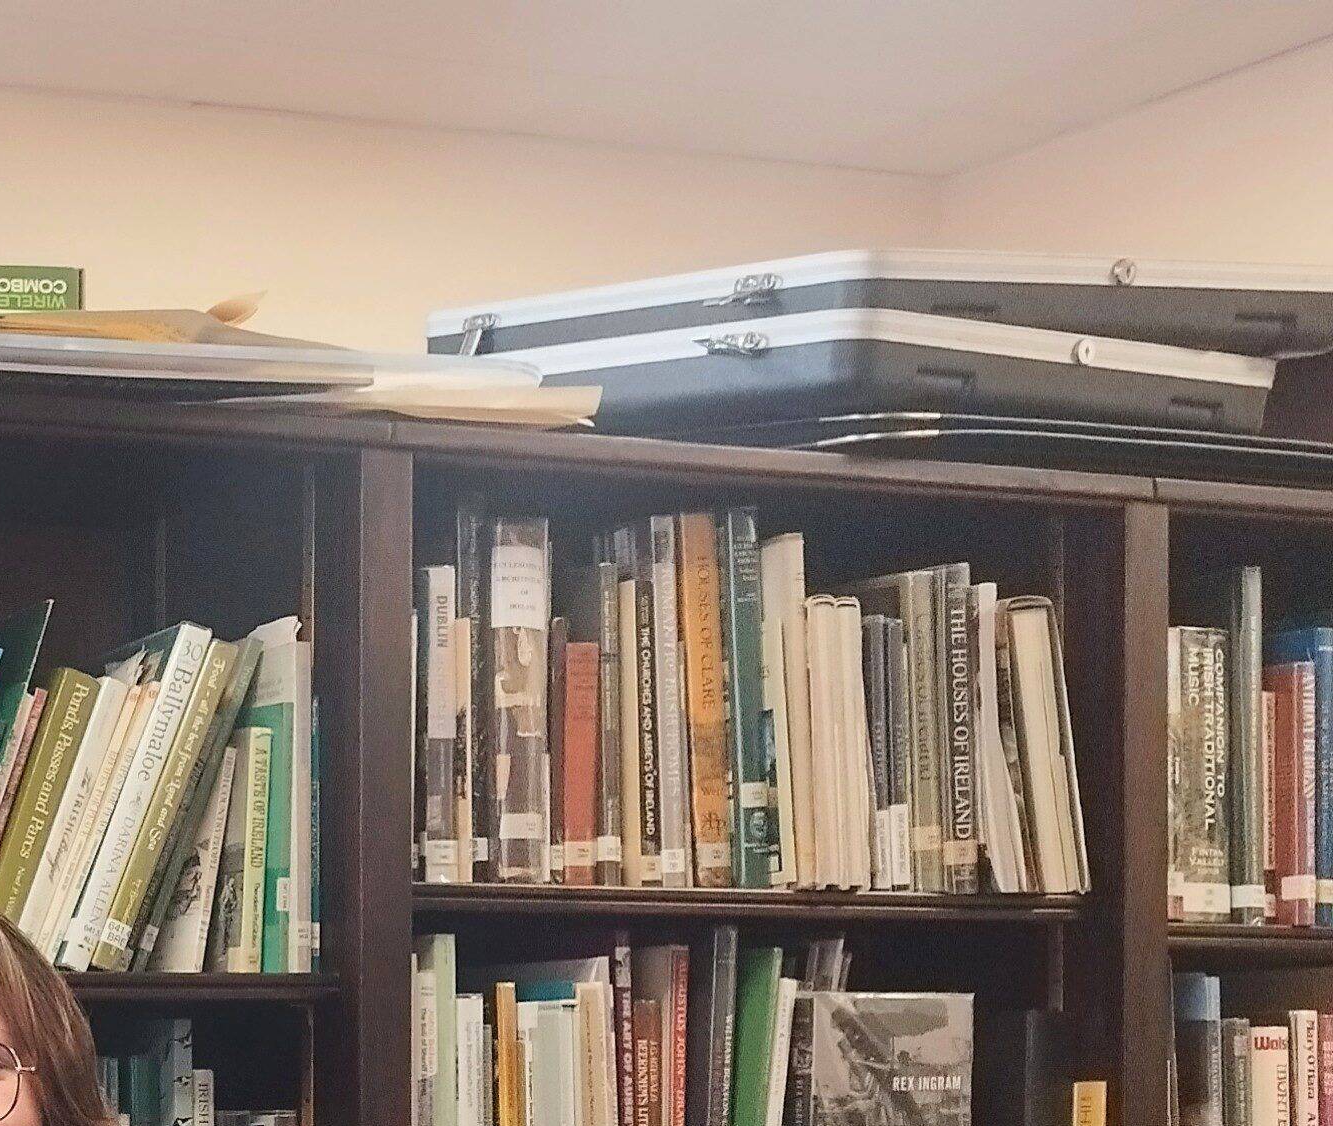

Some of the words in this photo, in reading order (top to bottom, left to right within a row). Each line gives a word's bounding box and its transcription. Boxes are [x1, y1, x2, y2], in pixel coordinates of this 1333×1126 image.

[696, 556, 714, 622] HOUSES
[436, 594, 449, 648] DUBLIN
[639, 627, 651, 648] THE
[700, 626, 716, 648] OF
[949, 608, 966, 646] THE
[205, 657, 226, 689] Food
[640, 649, 652, 705] CHURCHES
[700, 654, 717, 709] CLARE
[952, 648, 969, 722] HOUSES
[1186, 647, 1200, 707] MUSIC
[1203, 648, 1215, 697] IRISH
[60, 681, 90, 731] Ponds,
[136, 666, 194, 782] Ballymaloe
[188, 715, 204, 734] the
[196, 698, 211, 714] all
[1214, 648, 1226, 765] COMPANION
[181, 732, 199, 752] best
[253, 746, 268, 756] A
[953, 725, 970, 747] OF
[45, 732, 75, 782] Passes
[174, 751, 192, 778] from
[1204, 700, 1215, 830] TRADITIONAL
[35, 781, 60, 813] and
[954, 754, 972, 839] IRELAND
[1216, 772, 1226, 798] TO
[65, 793, 85, 833] IRISH
[154, 808, 173, 828] and
[251, 800, 266, 814] OF
[644, 789, 656, 836] IRELAND
[18, 815, 46, 860] Parcs
[104, 816, 137, 875] DARINA
[249, 816, 265, 869] IRELAND
[87, 879, 115, 925] ALLEN
[621, 990, 632, 1019] THE
[622, 1021, 634, 1050] ART
[723, 1013, 734, 1065] WILLIAM
[1303, 1019, 1316, 1053] Mary
[623, 1052, 634, 1072] OF
[676, 1036, 685, 1076] JOHN
[892, 1076, 914, 1091] REX
[918, 1075, 961, 1091] INGRAM
[197, 1082, 210, 1125] IRISH
